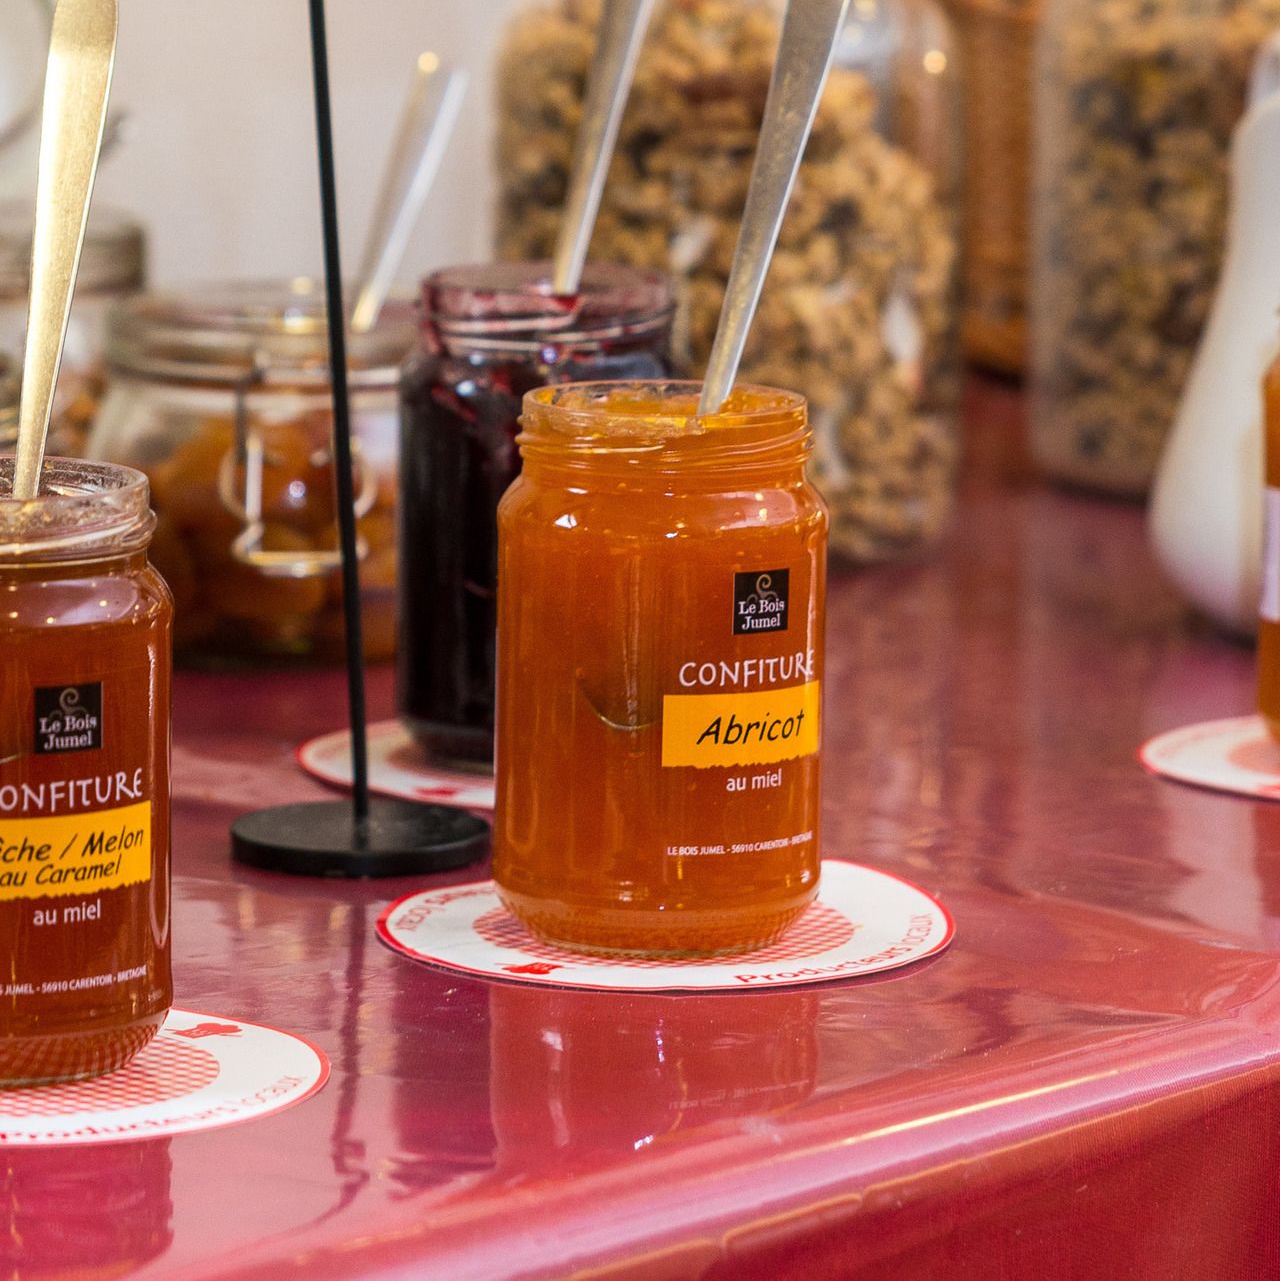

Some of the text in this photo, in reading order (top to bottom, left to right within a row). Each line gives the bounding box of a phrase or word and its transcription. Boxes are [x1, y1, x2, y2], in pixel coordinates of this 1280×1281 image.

[738, 597, 786, 615] Le Bois
[741, 612, 782, 630] Jumel
[678, 649, 815, 688] CONFITURE
[39, 714, 98, 734] Le Bois
[696, 708, 806, 747] Abricot
[43, 731, 94, 751] Jumel
[726, 768, 783, 792] au miel
[59, 832, 79, 860] /
[81, 824, 145, 858] Melon
[667, 846, 678, 856] LE
[678, 845, 699, 856] BOIS
[699, 845, 726, 856] JUMEL
[35, 854, 123, 885] Caramel
[33, 898, 102, 927] au miel
[734, 943, 913, 983] Producteurs
[4, 982, 35, 996] JUMEL
[41, 980, 68, 994] 56910
[69, 973, 113, 991] CARENTOIR
[222, 1073, 308, 1108] locaux
